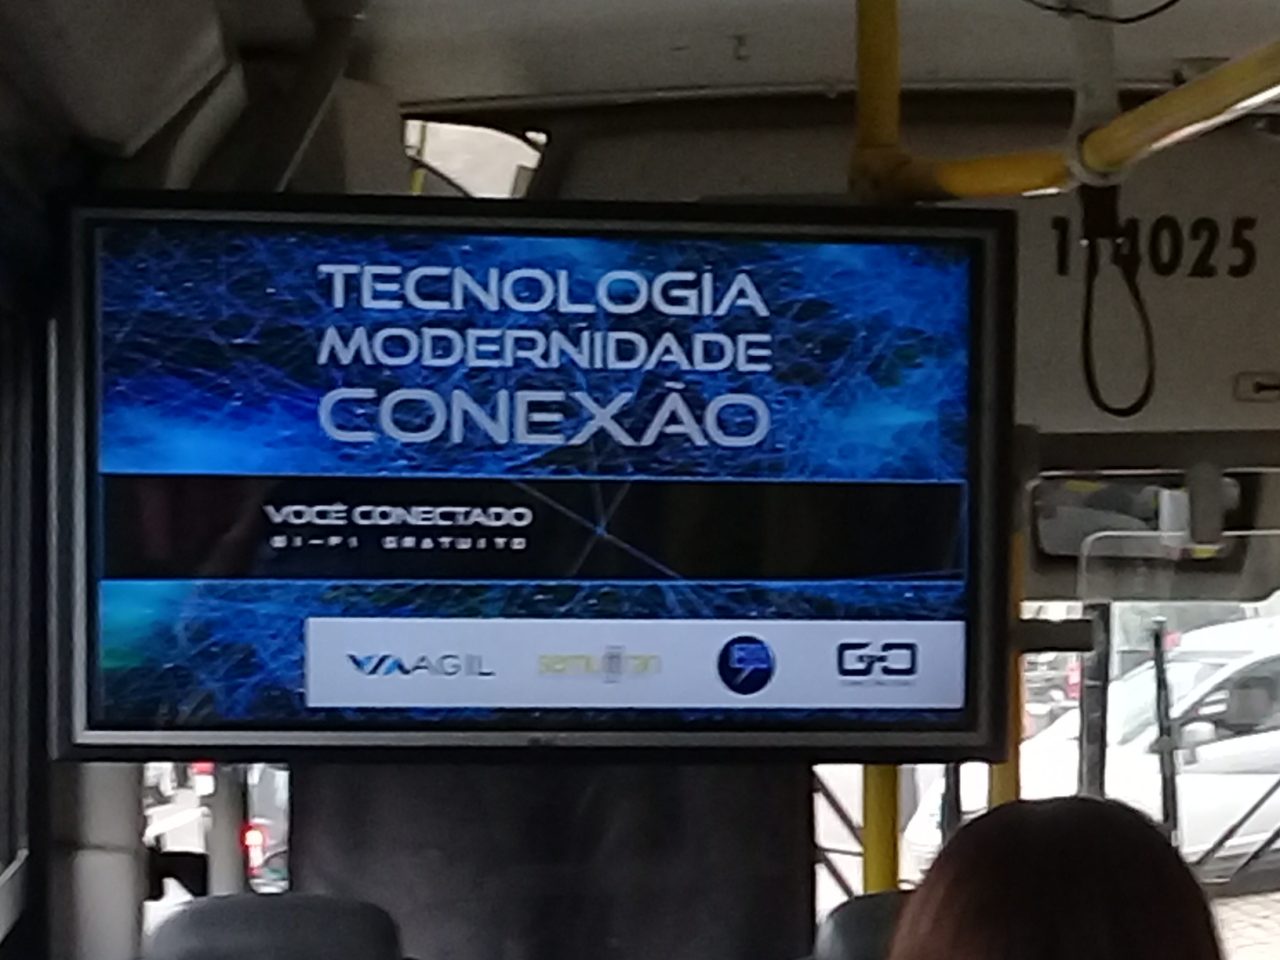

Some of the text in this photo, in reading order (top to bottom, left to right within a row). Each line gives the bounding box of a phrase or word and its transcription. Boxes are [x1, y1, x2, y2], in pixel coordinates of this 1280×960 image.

[317, 263, 770, 317] TECNOLOGIA
[317, 326, 773, 372] MODERNIDADE
[318, 381, 771, 448] CONEXÃO
[262, 501, 533, 526] VOCÊ CONECTADO
